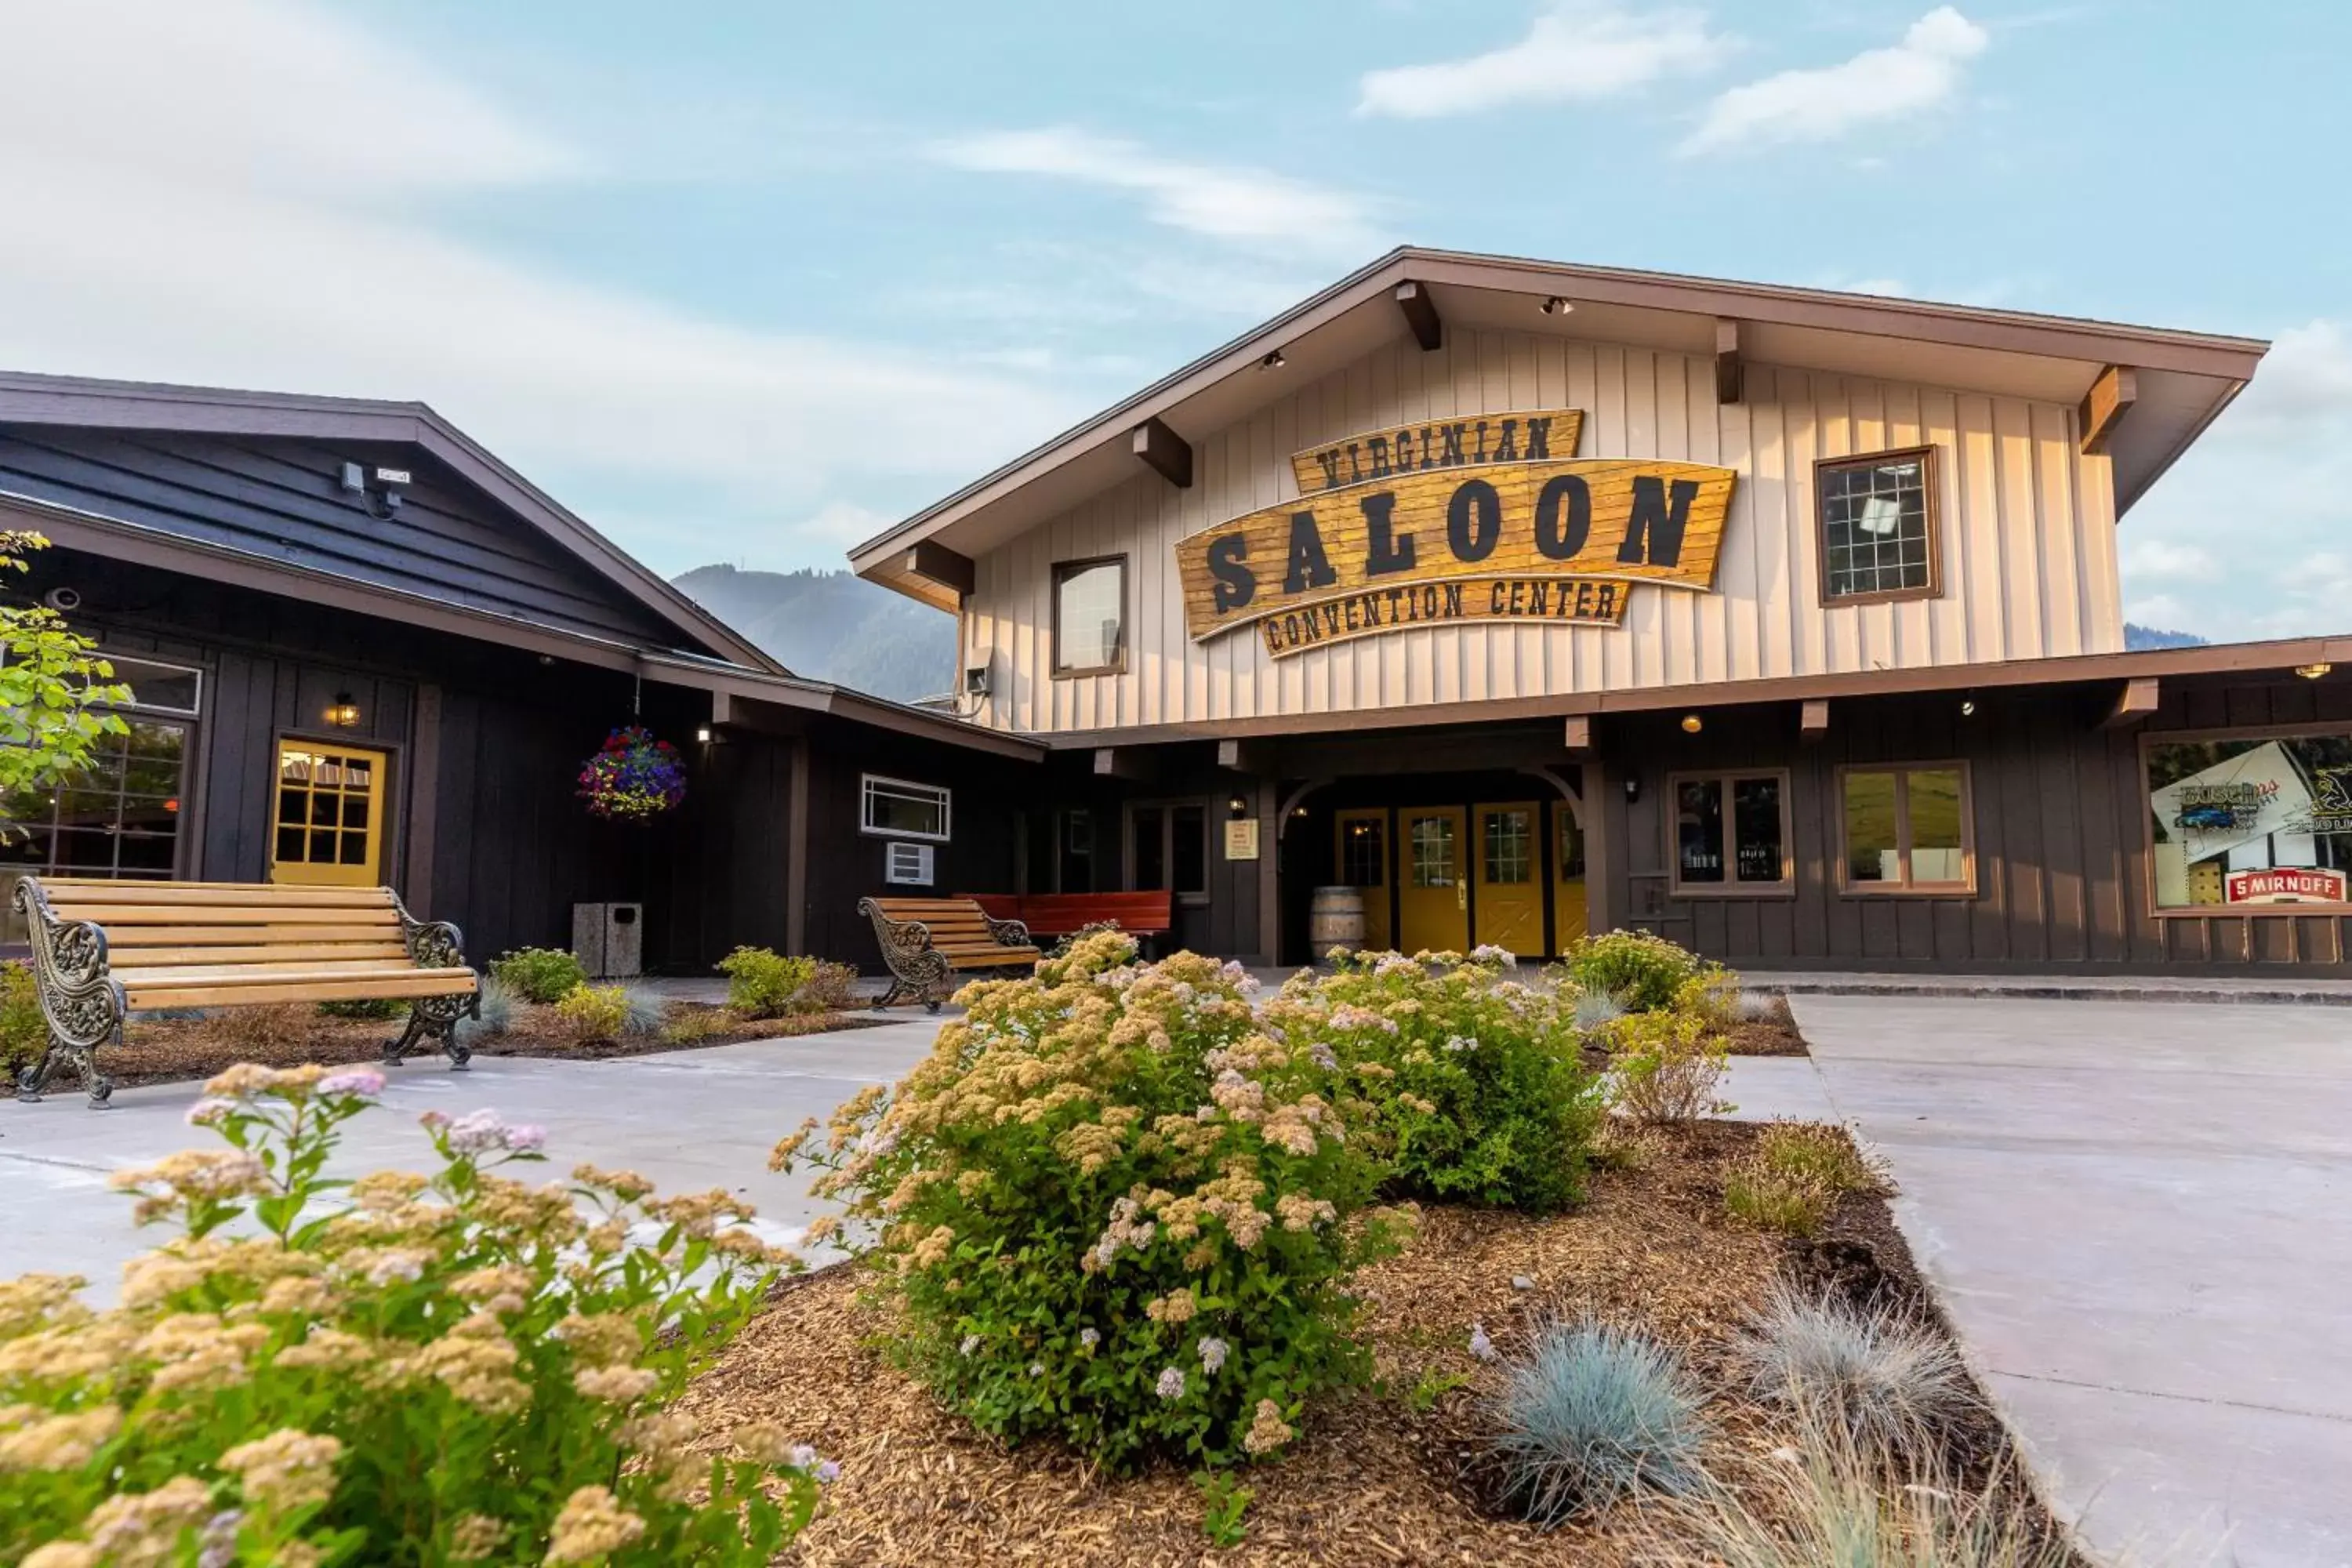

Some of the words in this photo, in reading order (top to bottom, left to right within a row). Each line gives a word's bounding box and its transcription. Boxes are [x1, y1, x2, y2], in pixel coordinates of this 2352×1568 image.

[1316, 417, 1553, 491] VIRGINIAN
[1206, 474, 1700, 615] SALOON
[1266, 584, 1463, 651] CONVENTION
[1490, 581, 1616, 619] CENTER
[2236, 876, 2334, 895] SMIRNOFF
